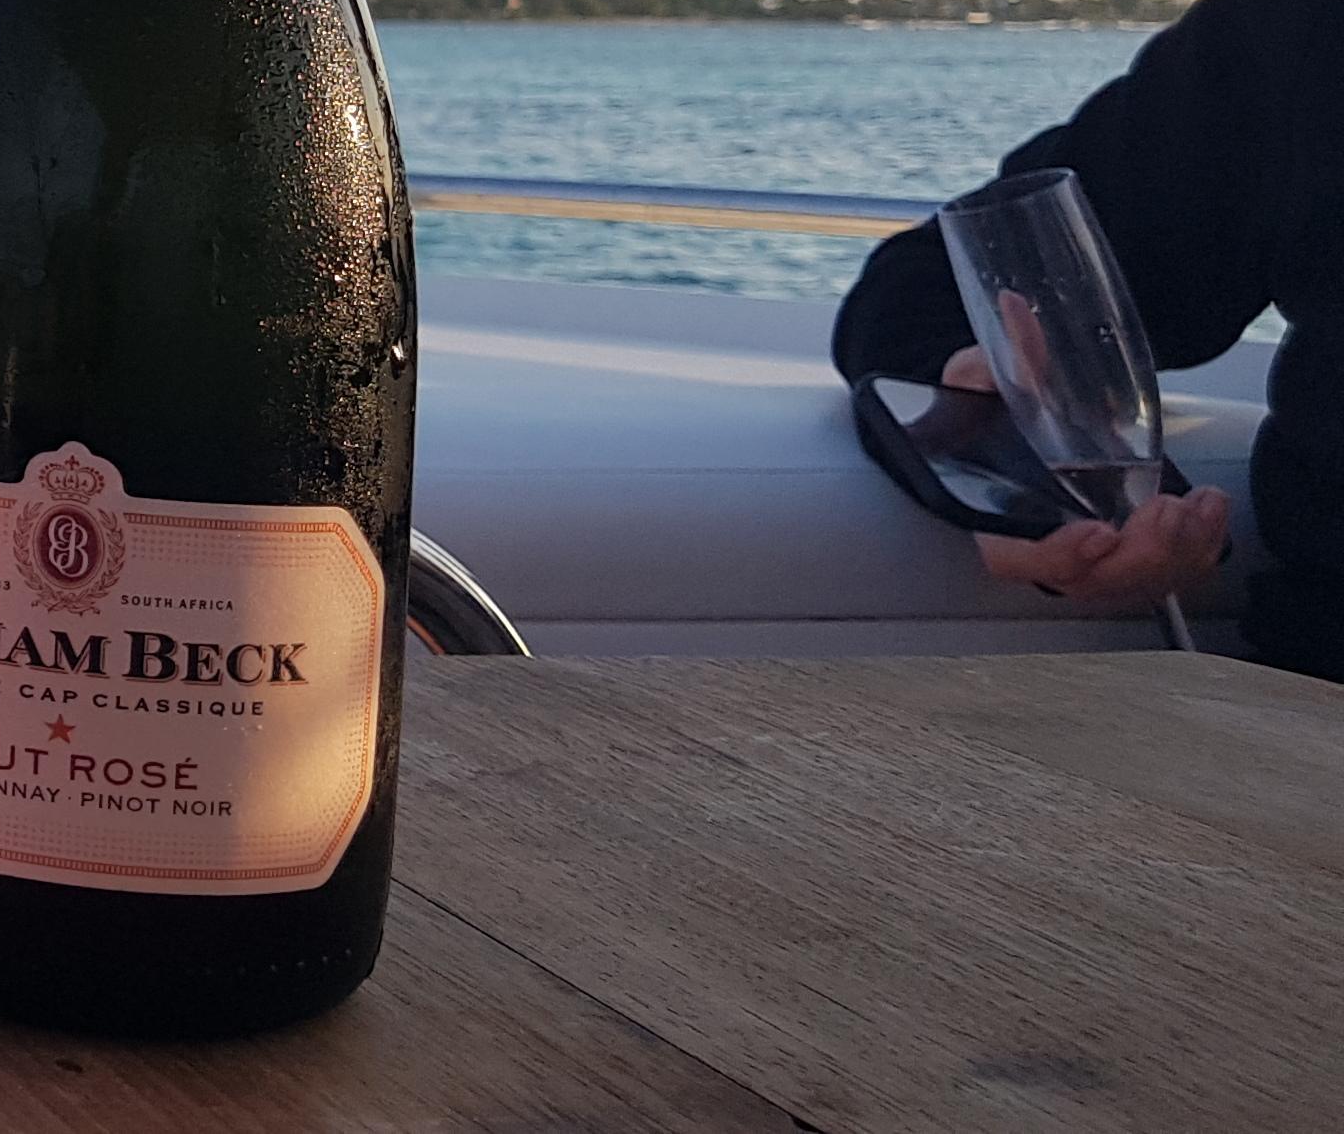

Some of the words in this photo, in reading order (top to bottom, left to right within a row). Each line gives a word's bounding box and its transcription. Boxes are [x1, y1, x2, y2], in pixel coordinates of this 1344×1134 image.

[121, 594, 173, 608] SOUTH
[179, 598, 234, 611] AFRICA
[122, 630, 309, 686] BECK
[19, 684, 79, 704] CAP
[92, 693, 264, 717] CLASSIQUE
[69, 757, 199, 791] ROSÉ
[80, 792, 161, 814] PINOT
[172, 800, 233, 817] NOIR
